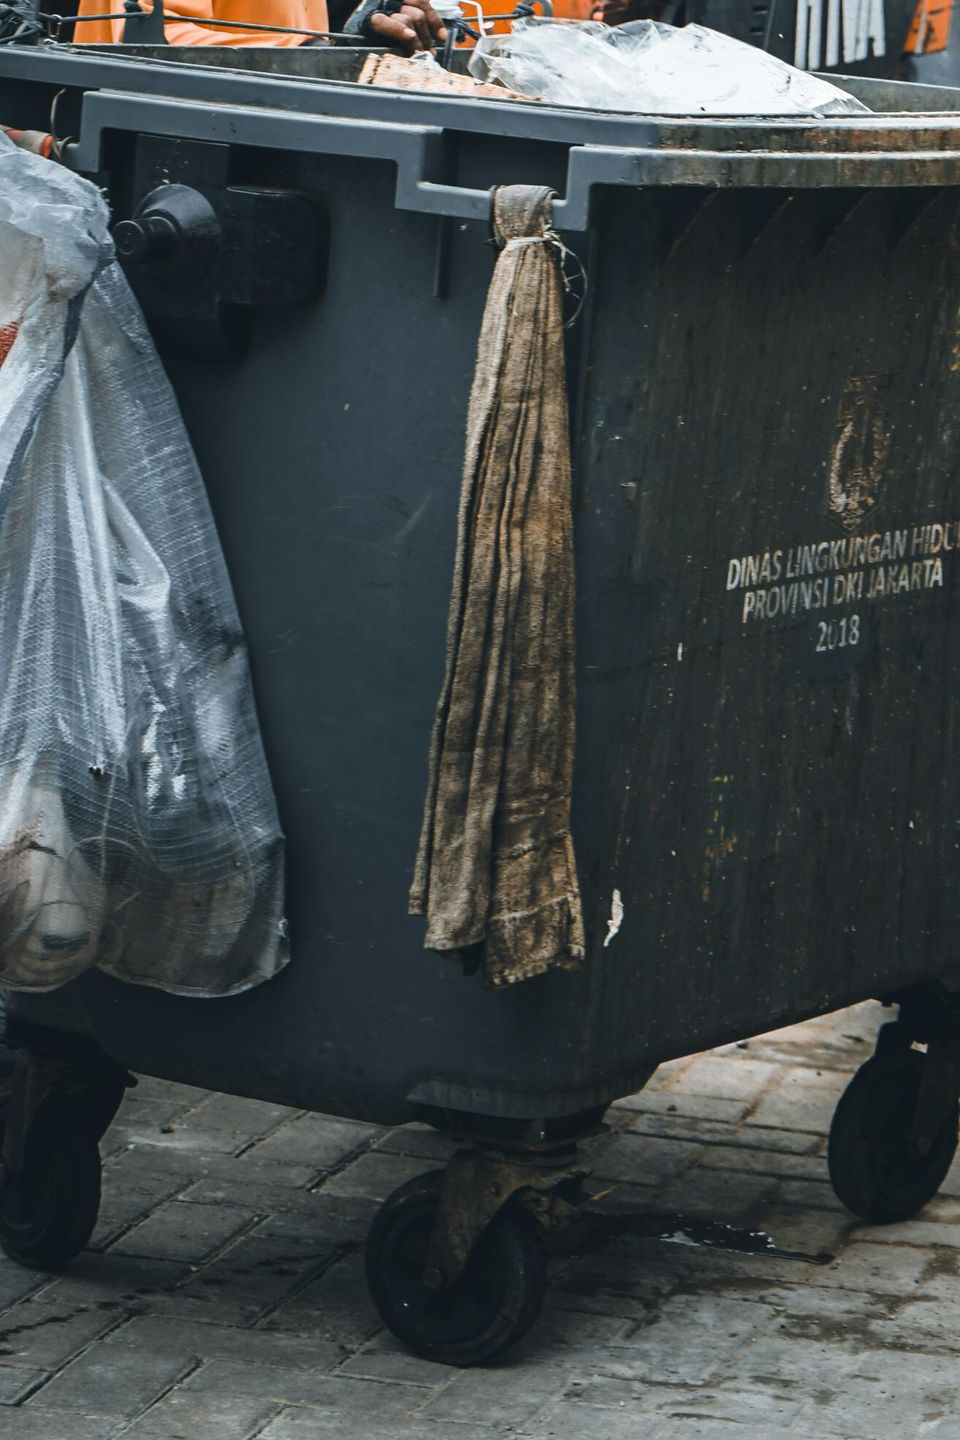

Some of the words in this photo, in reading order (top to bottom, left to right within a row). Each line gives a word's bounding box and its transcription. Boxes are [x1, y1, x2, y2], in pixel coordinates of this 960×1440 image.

[726, 549, 783, 591] DINAS
[786, 529, 908, 579] LINGKUNGAN
[742, 577, 829, 623] PROVINSI
[833, 571, 863, 606] DKI
[867, 557, 943, 599] JAKARTA
[815, 614, 860, 652] 2018
